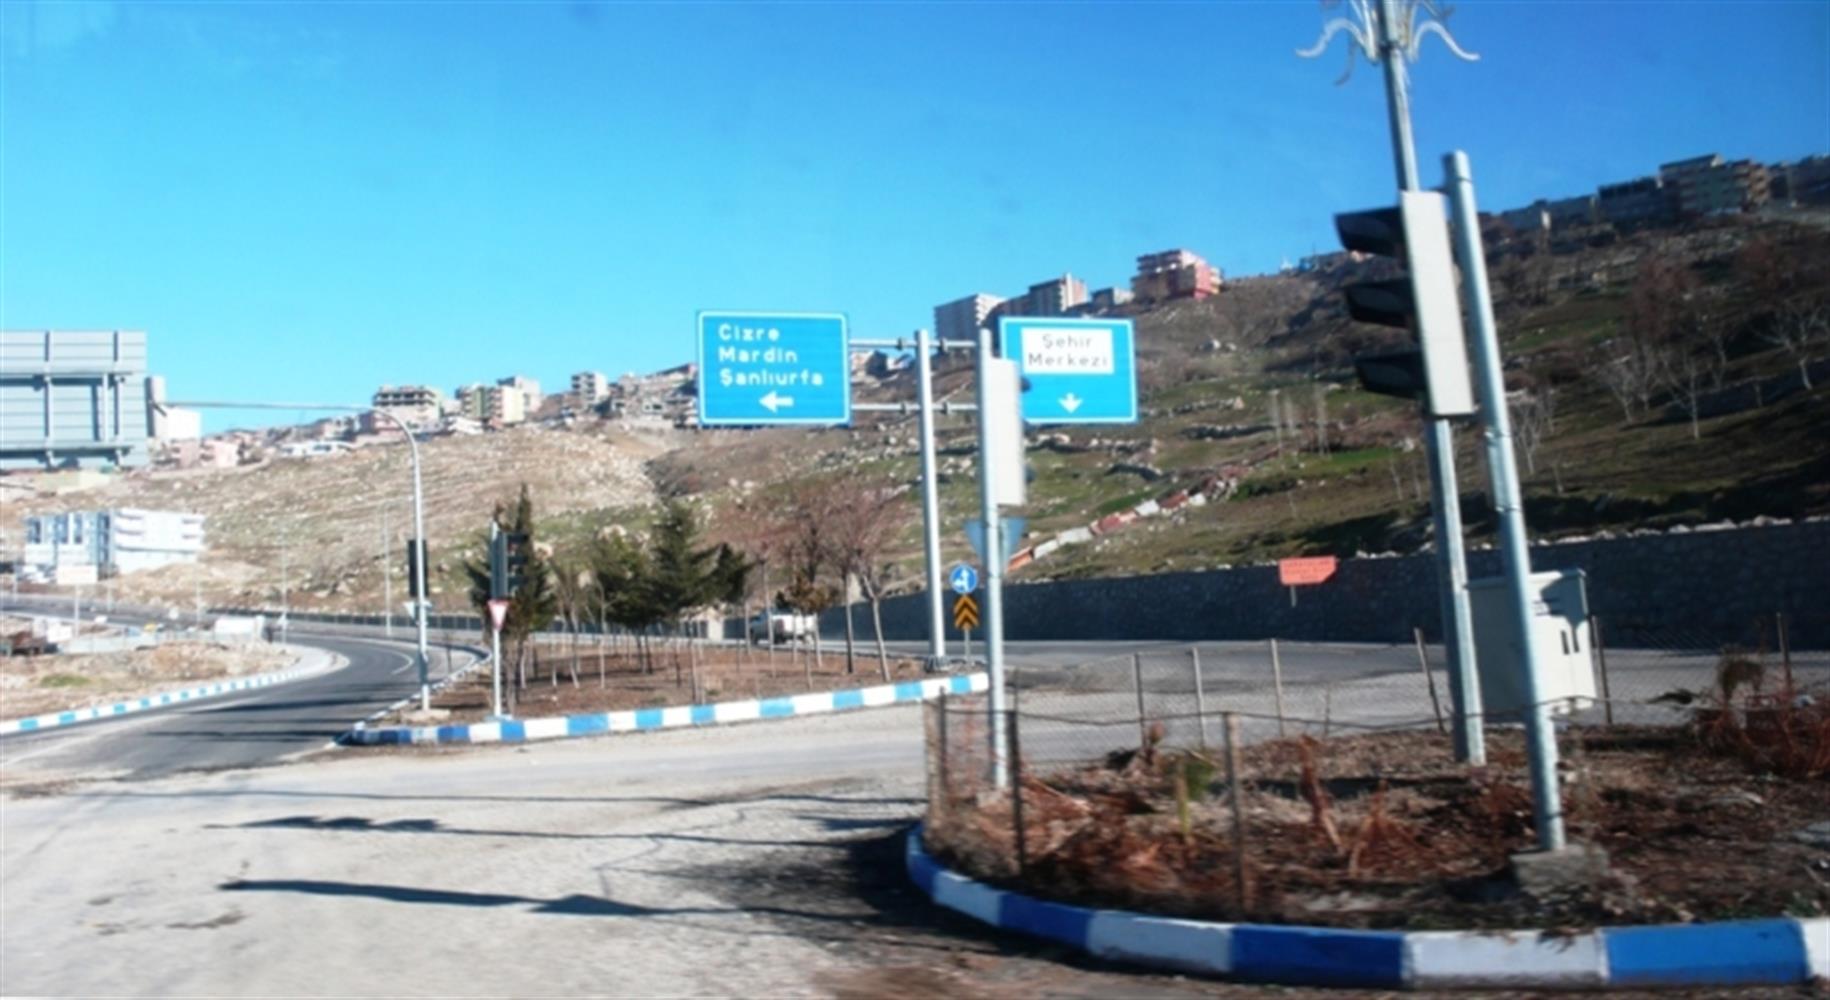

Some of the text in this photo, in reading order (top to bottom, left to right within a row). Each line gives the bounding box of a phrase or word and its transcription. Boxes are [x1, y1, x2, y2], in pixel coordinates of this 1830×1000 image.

[719, 323, 779, 340] Cizre
[1042, 333, 1091, 349] Şehir
[719, 346, 797, 362] Mardin
[1028, 353, 1108, 367] Merkezi
[720, 368, 823, 386] Şanlıurfa
